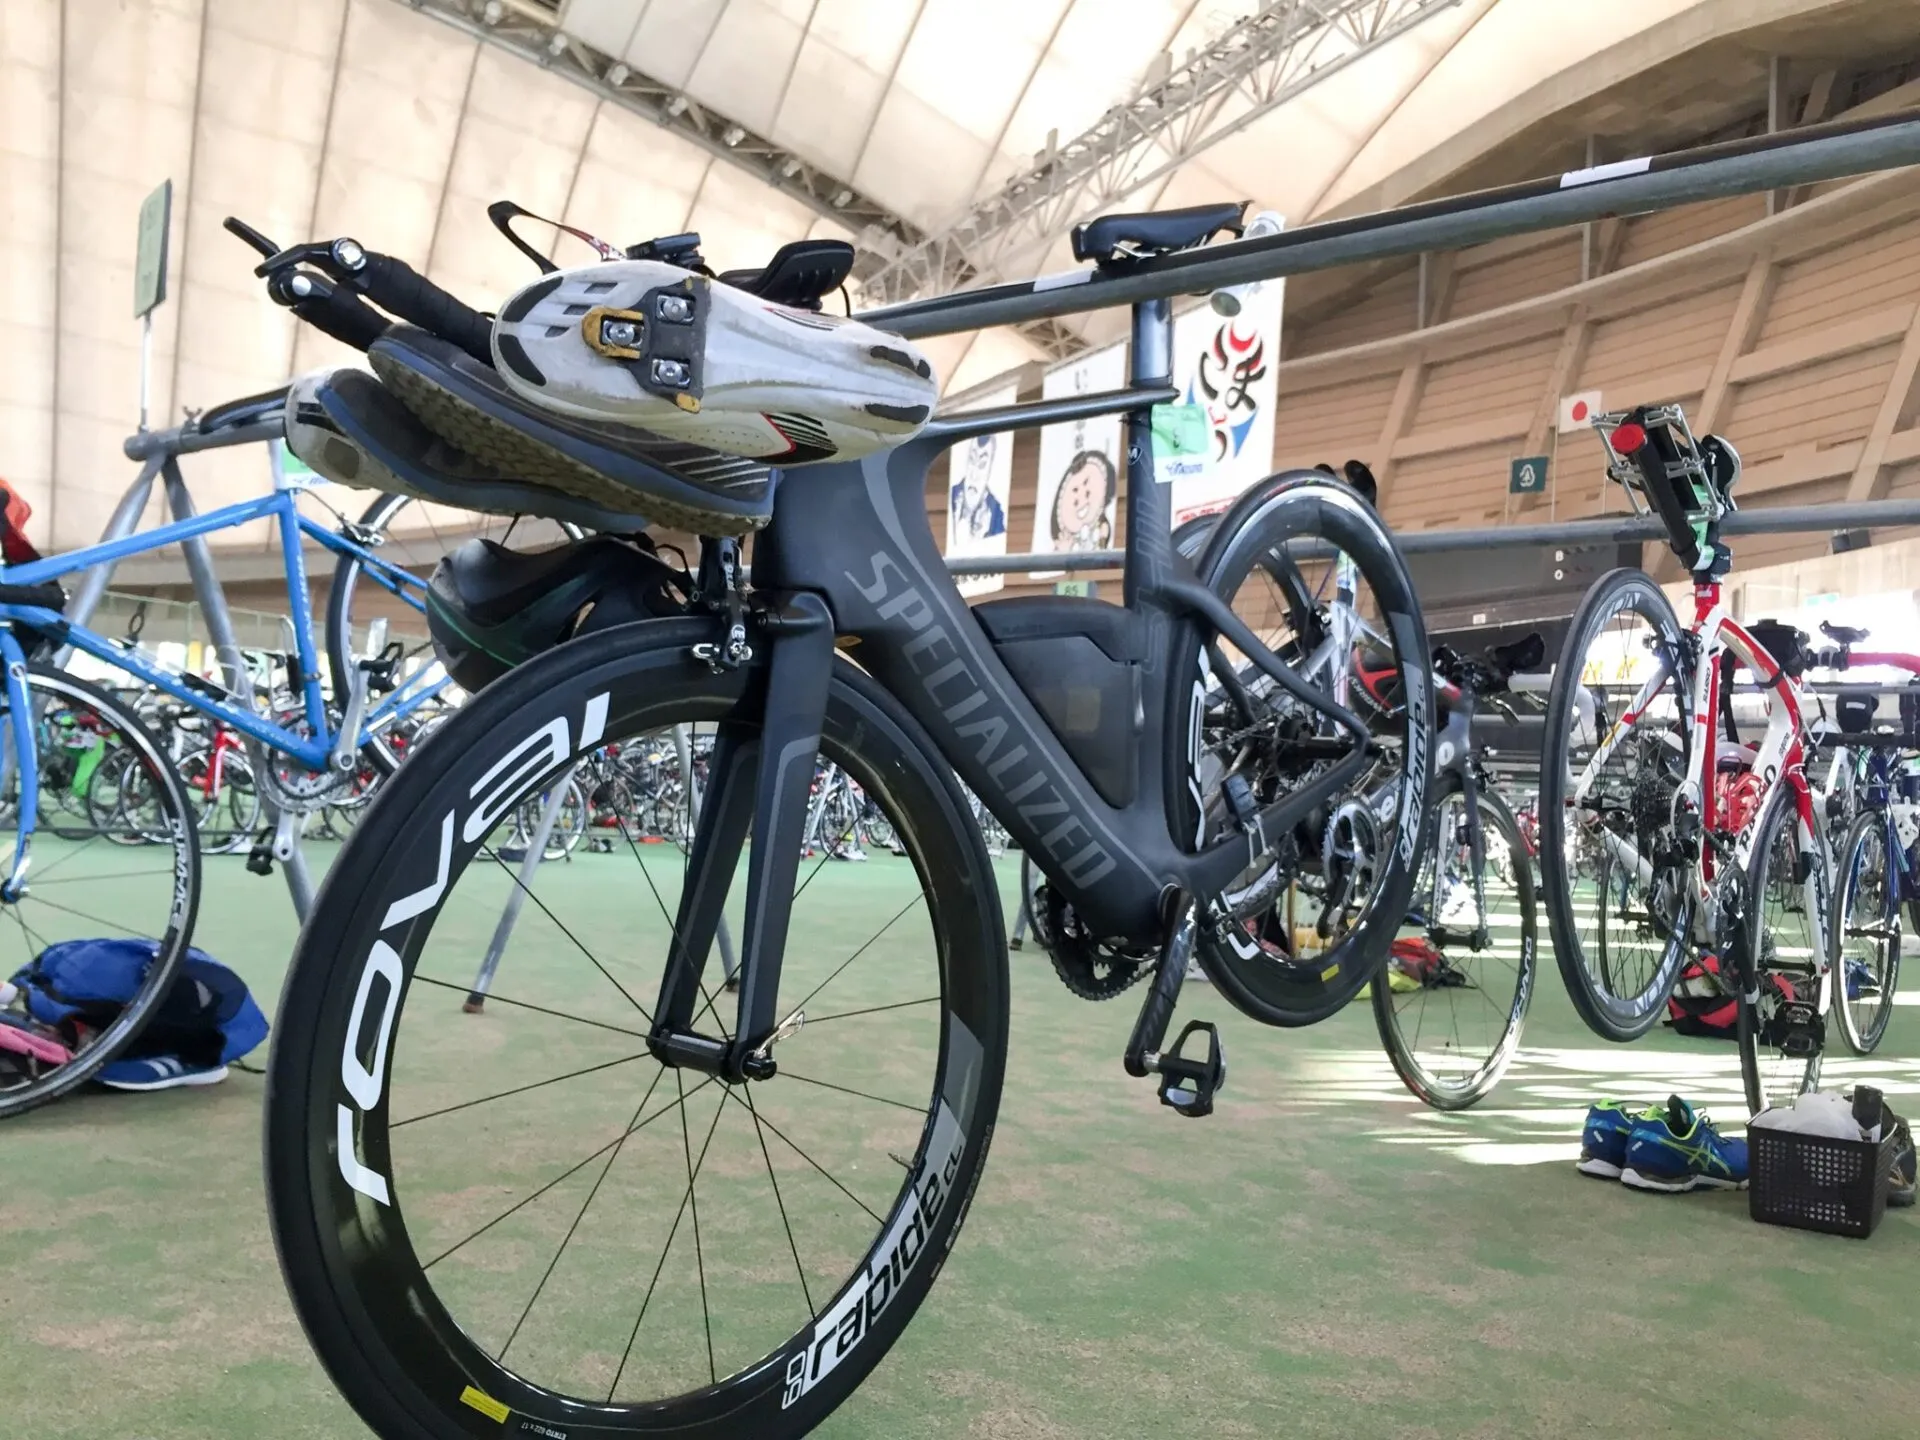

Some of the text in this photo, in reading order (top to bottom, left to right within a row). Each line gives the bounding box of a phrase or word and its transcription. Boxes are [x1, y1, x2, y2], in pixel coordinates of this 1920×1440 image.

[846, 551, 1118, 889] SPECIALIZED
[337, 691, 611, 1207] roval
[782, 1350, 808, 1411] 60
[809, 1158, 946, 1382] rapide
[943, 1144, 963, 1187] CL
